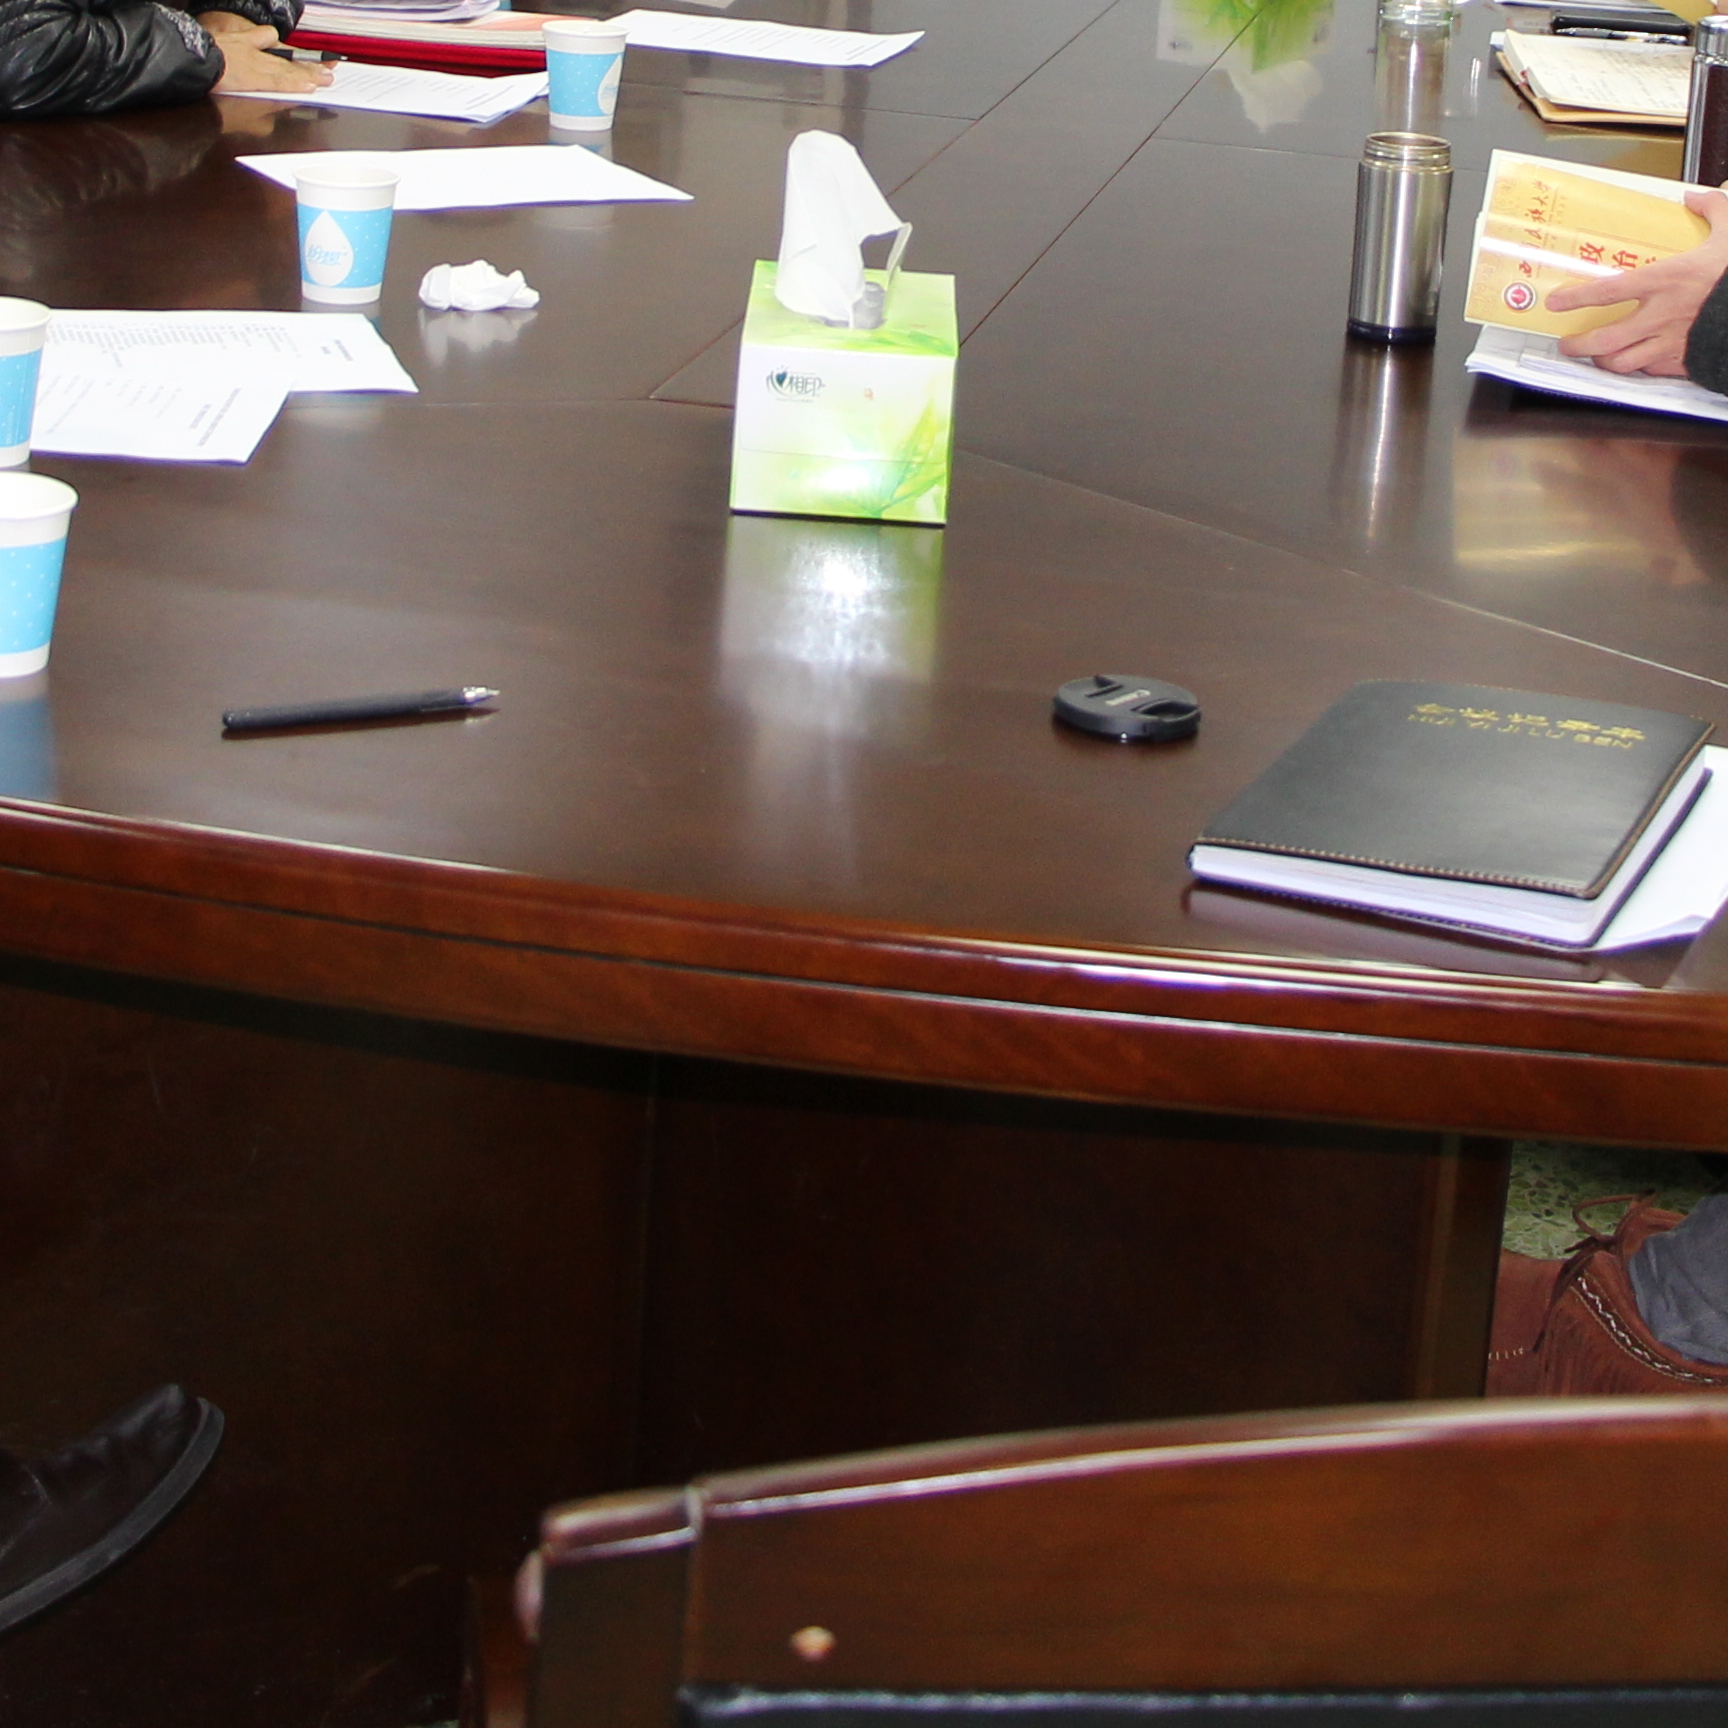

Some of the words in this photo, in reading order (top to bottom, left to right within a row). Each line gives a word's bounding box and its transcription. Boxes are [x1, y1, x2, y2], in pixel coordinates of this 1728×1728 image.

[1518, 178, 1551, 278] 西民族大学
[765, 364, 824, 399] 心相印
